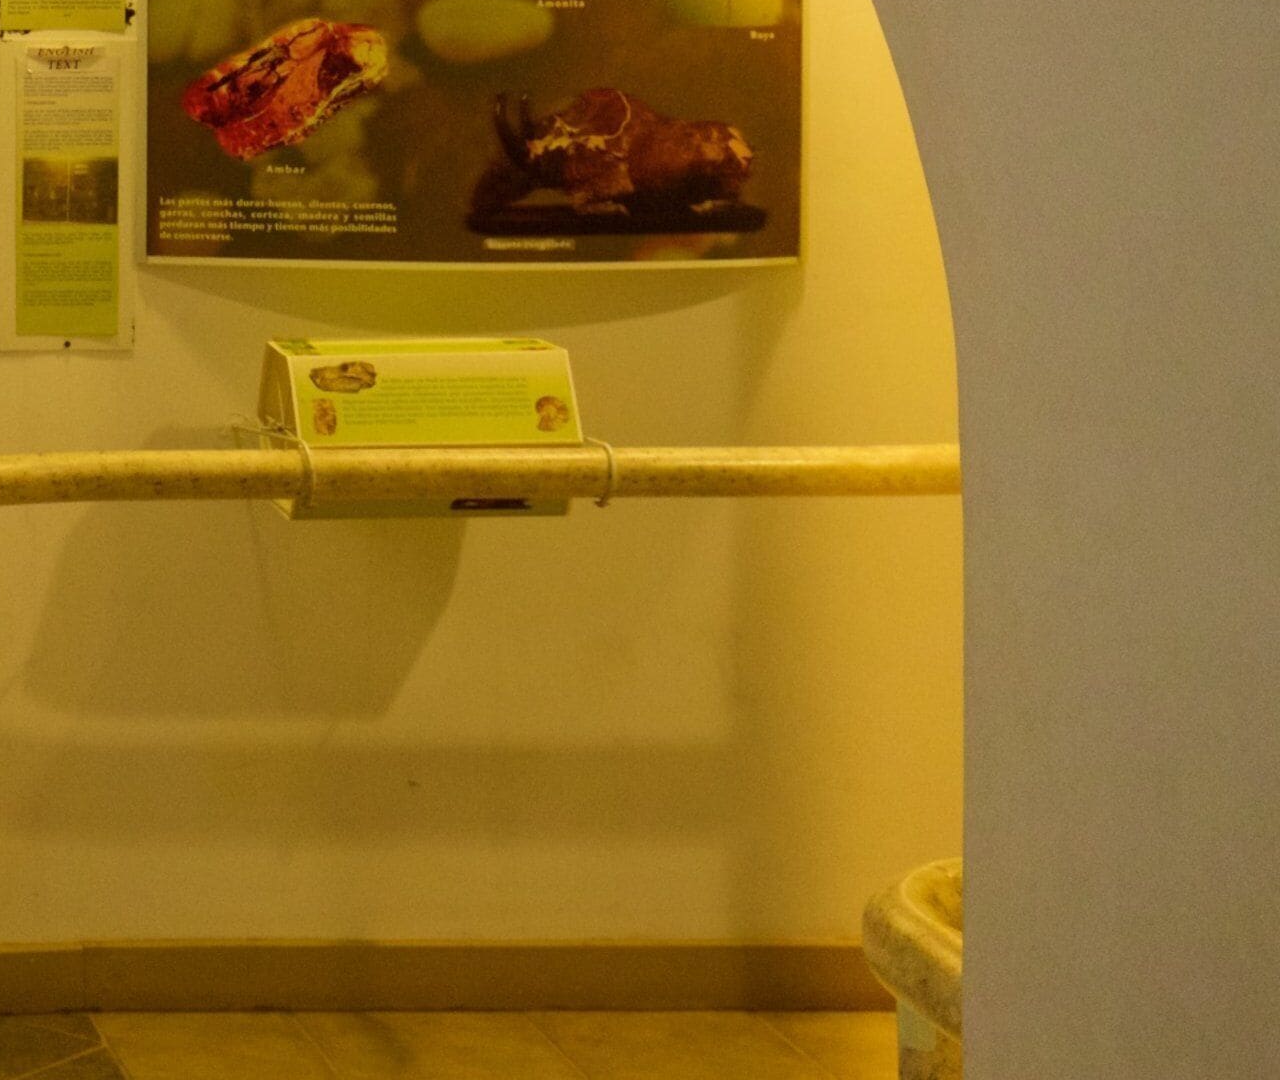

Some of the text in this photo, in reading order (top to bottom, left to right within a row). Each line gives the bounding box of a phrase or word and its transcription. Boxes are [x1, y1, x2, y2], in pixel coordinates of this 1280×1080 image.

[536, 0, 586, 9] Amonita
[47, 59, 82, 70] TEXT
[266, 165, 306, 175] Ambar
